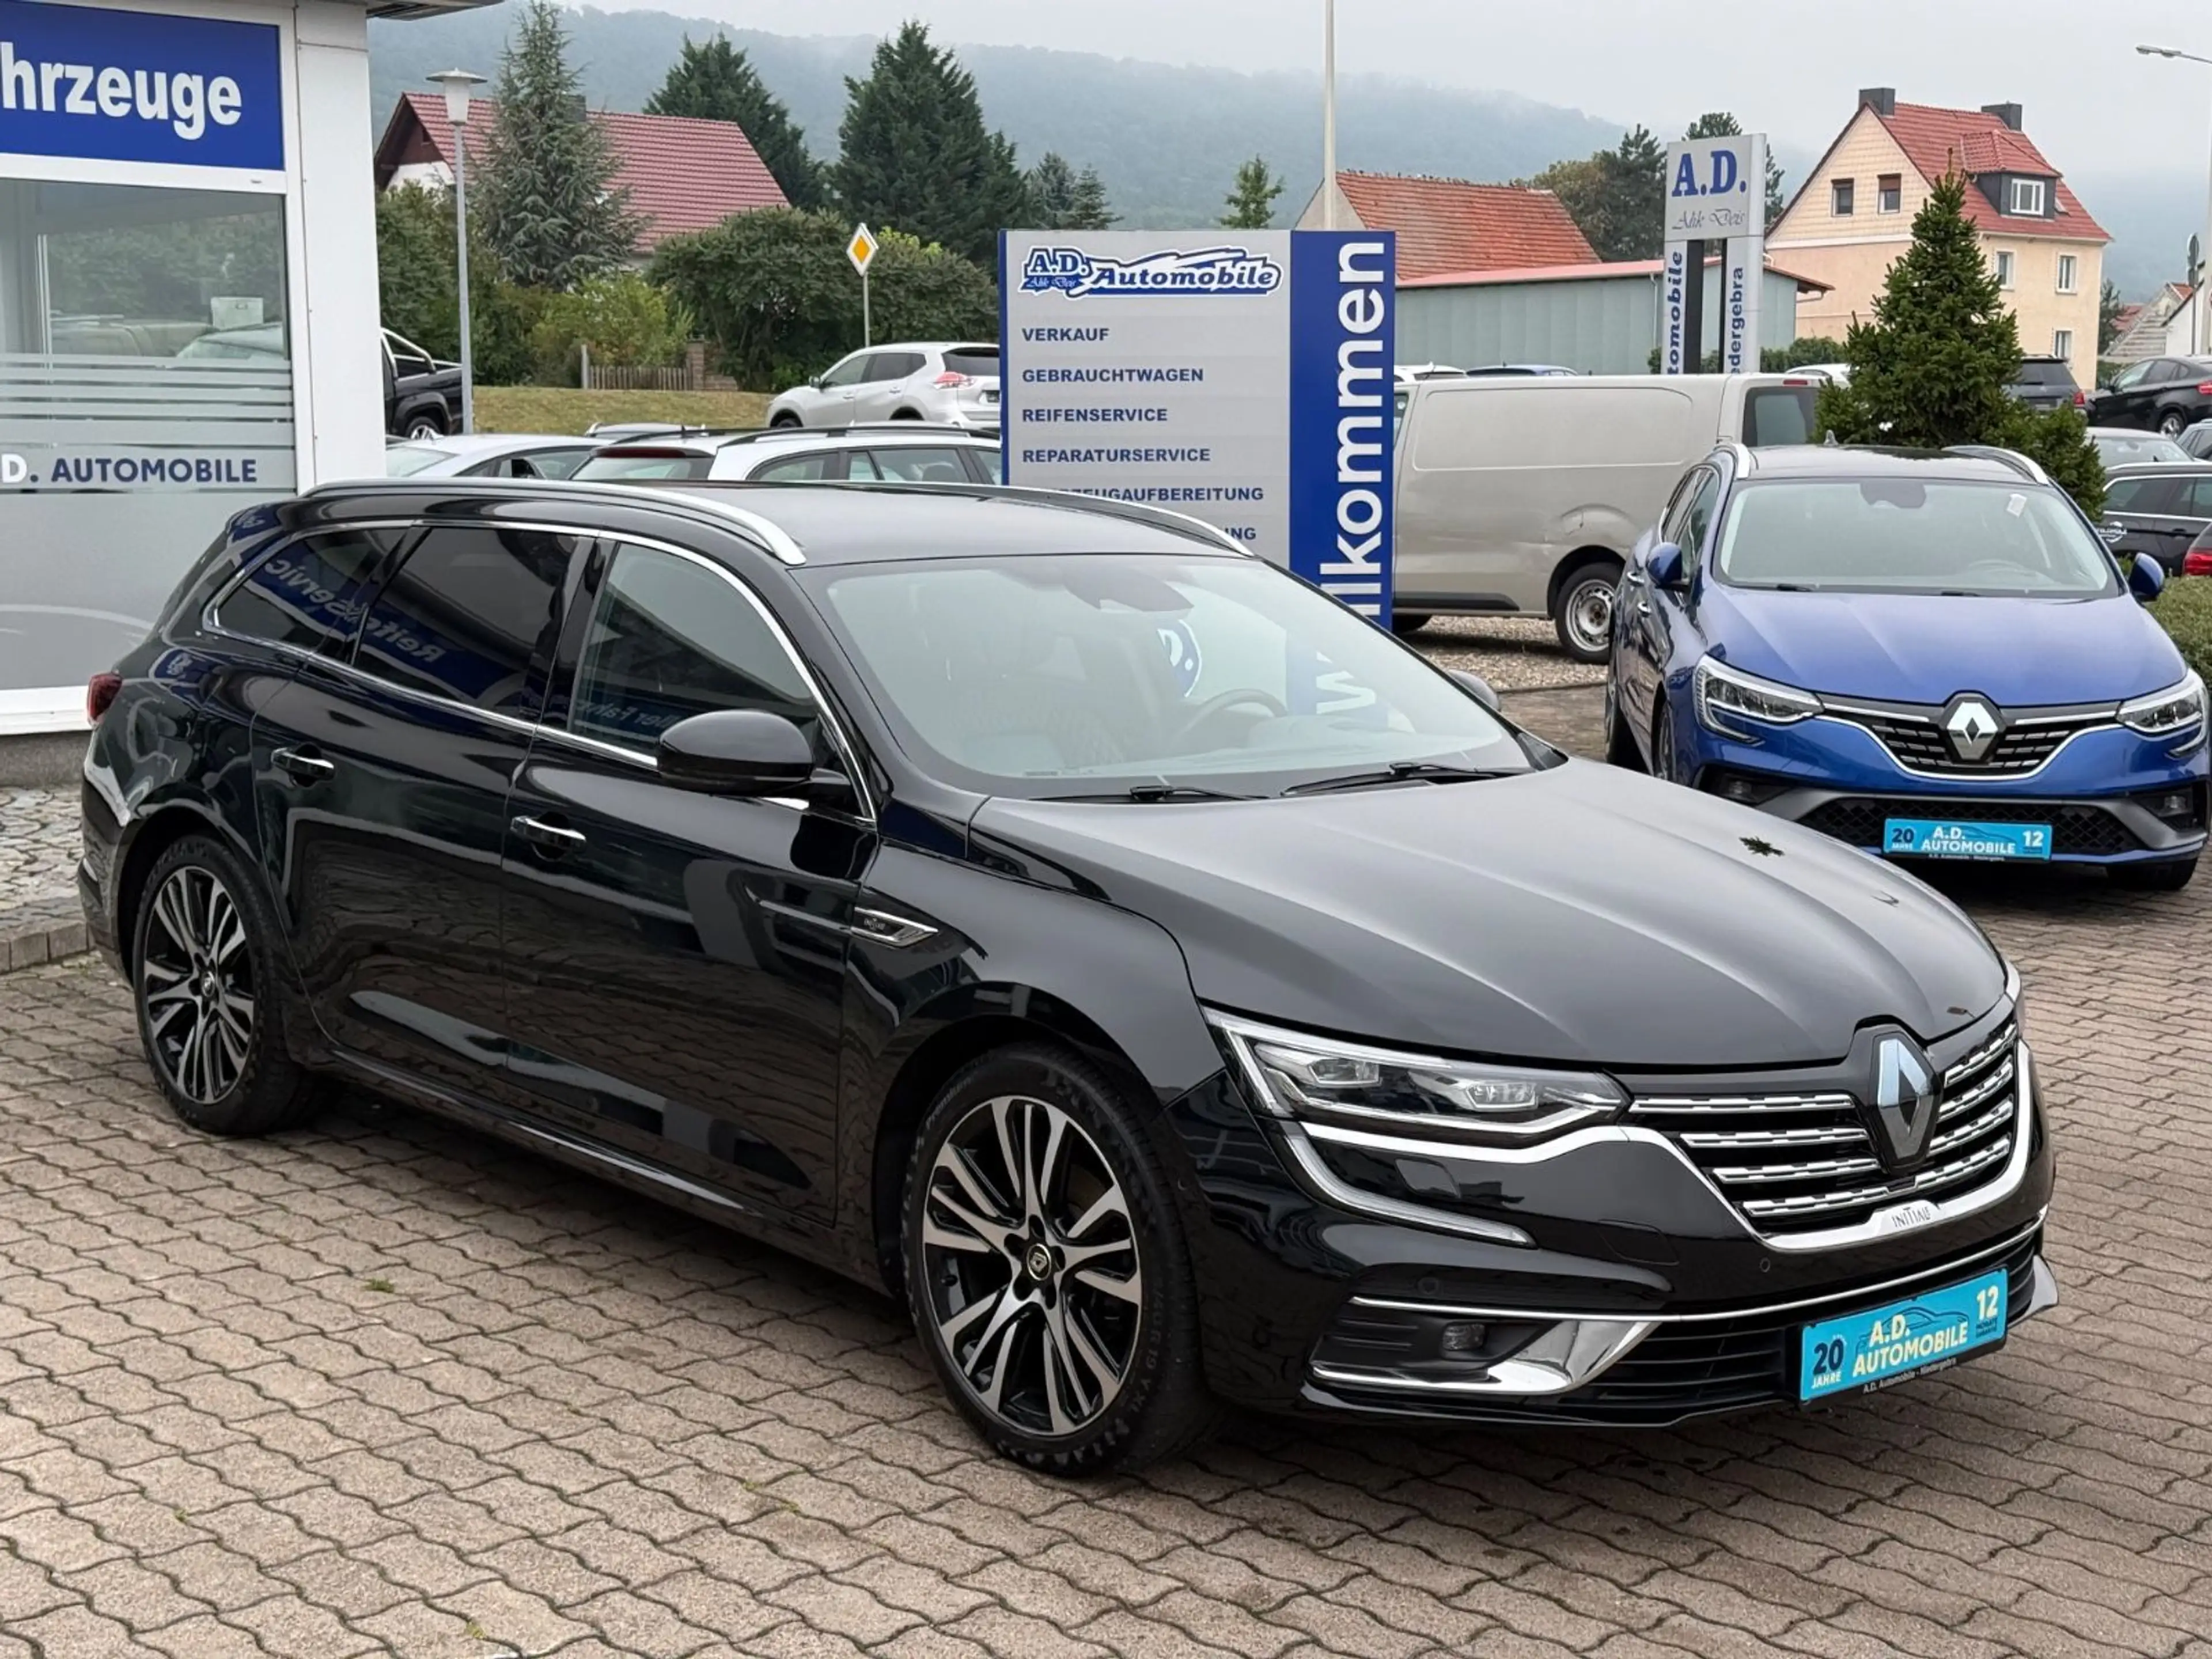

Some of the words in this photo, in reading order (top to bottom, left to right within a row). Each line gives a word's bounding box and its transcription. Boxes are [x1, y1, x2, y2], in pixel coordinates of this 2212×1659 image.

[0, 41, 242, 140] hrzeuge
[1672, 150, 1747, 196] A.D.
[1030, 253, 1088, 274] A.D.
[1090, 265, 1273, 286] Automobile
[1022, 328, 1110, 342] VERKAUF
[1022, 368, 1204, 382] GEBRAUCHTWAGEN
[1022, 408, 1168, 422] REIFENSERVICE
[1022, 448, 1211, 463] REPARATURSERVICE
[51, 458, 257, 483] AUTOMOBILE
[1892, 828, 1914, 843] 20
[1933, 825, 1966, 840] A.D.
[2022, 830, 2044, 847] 12
[1921, 839, 2016, 854] AUTOMOBILE
[1976, 1285, 1999, 1321] 12
[1869, 1315, 1910, 1347] A.D.
[1813, 1338, 1843, 1375] 20
[1853, 1321, 1968, 1377] AUTOMOBILE
[1811, 1370, 1841, 1389] JAHRE
